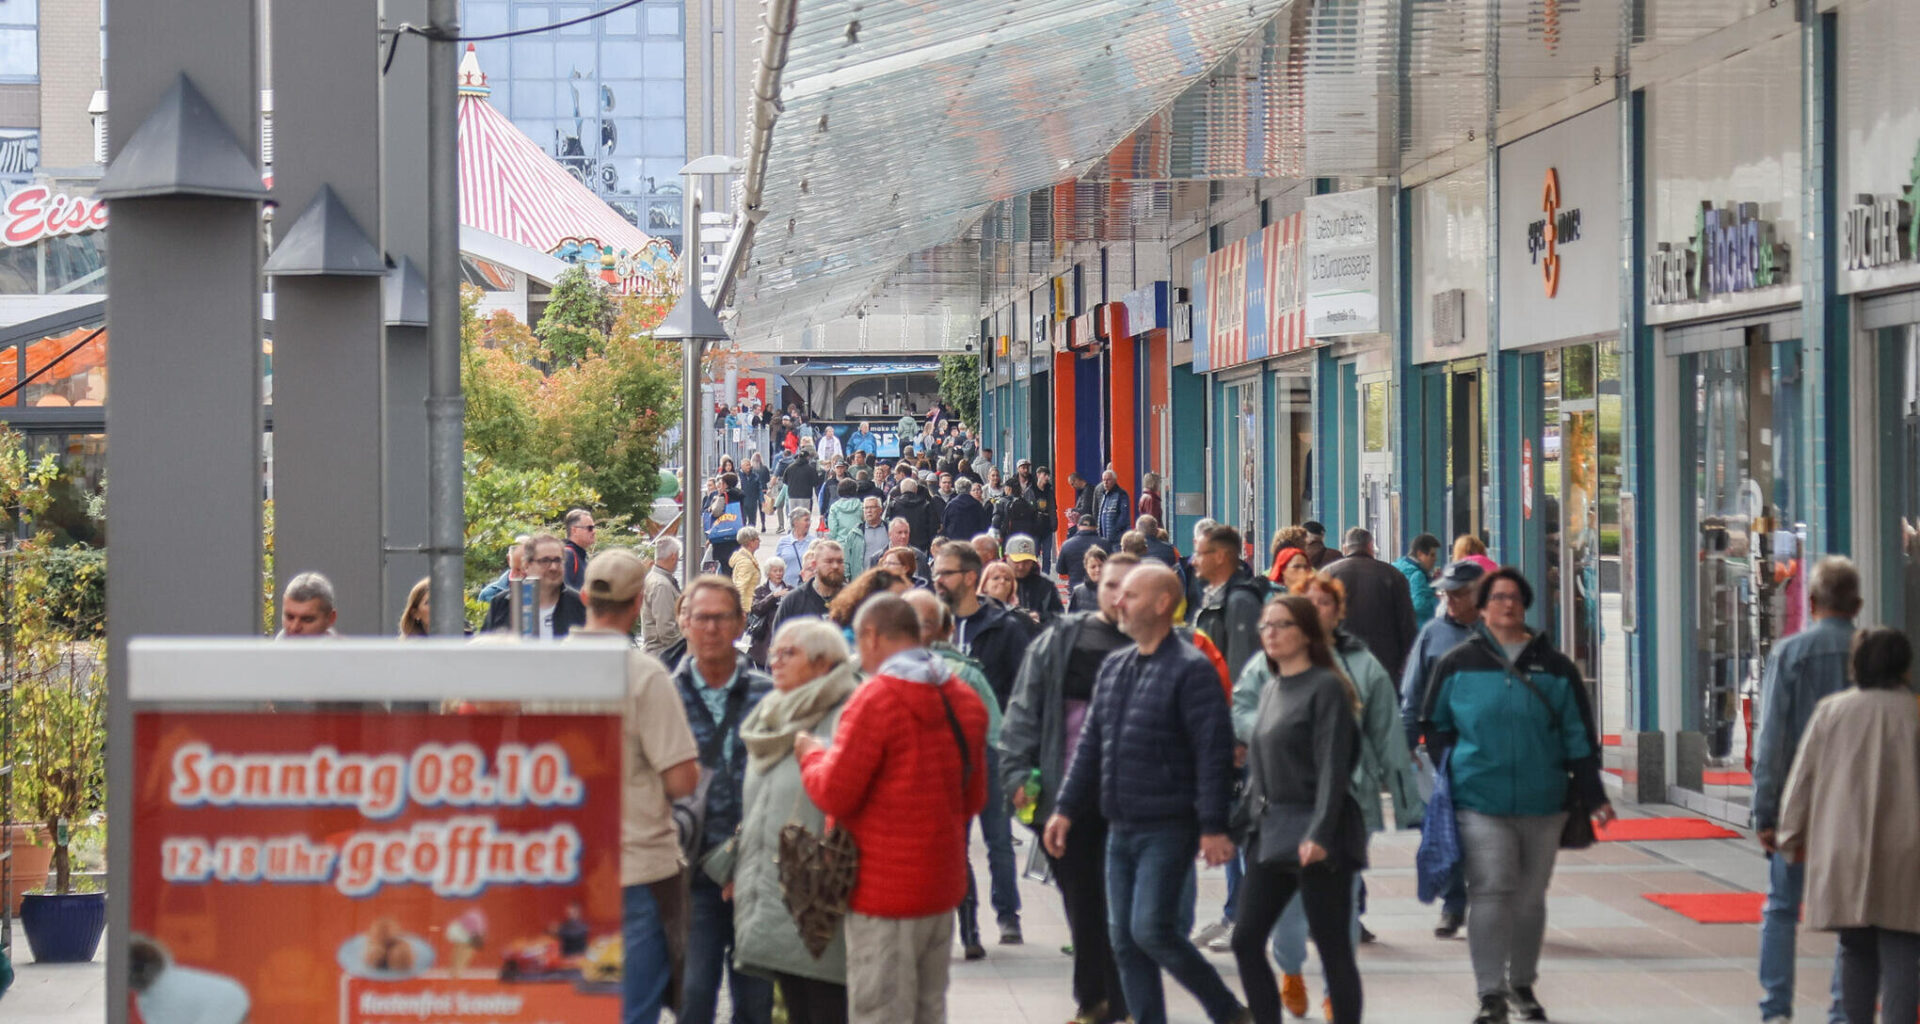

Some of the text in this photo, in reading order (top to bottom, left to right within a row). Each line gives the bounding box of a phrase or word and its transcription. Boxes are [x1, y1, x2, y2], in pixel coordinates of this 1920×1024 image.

[172, 744, 581, 817] Sonntag 08.10.
[163, 817, 580, 896] 12-18 Uhr geöffnet
